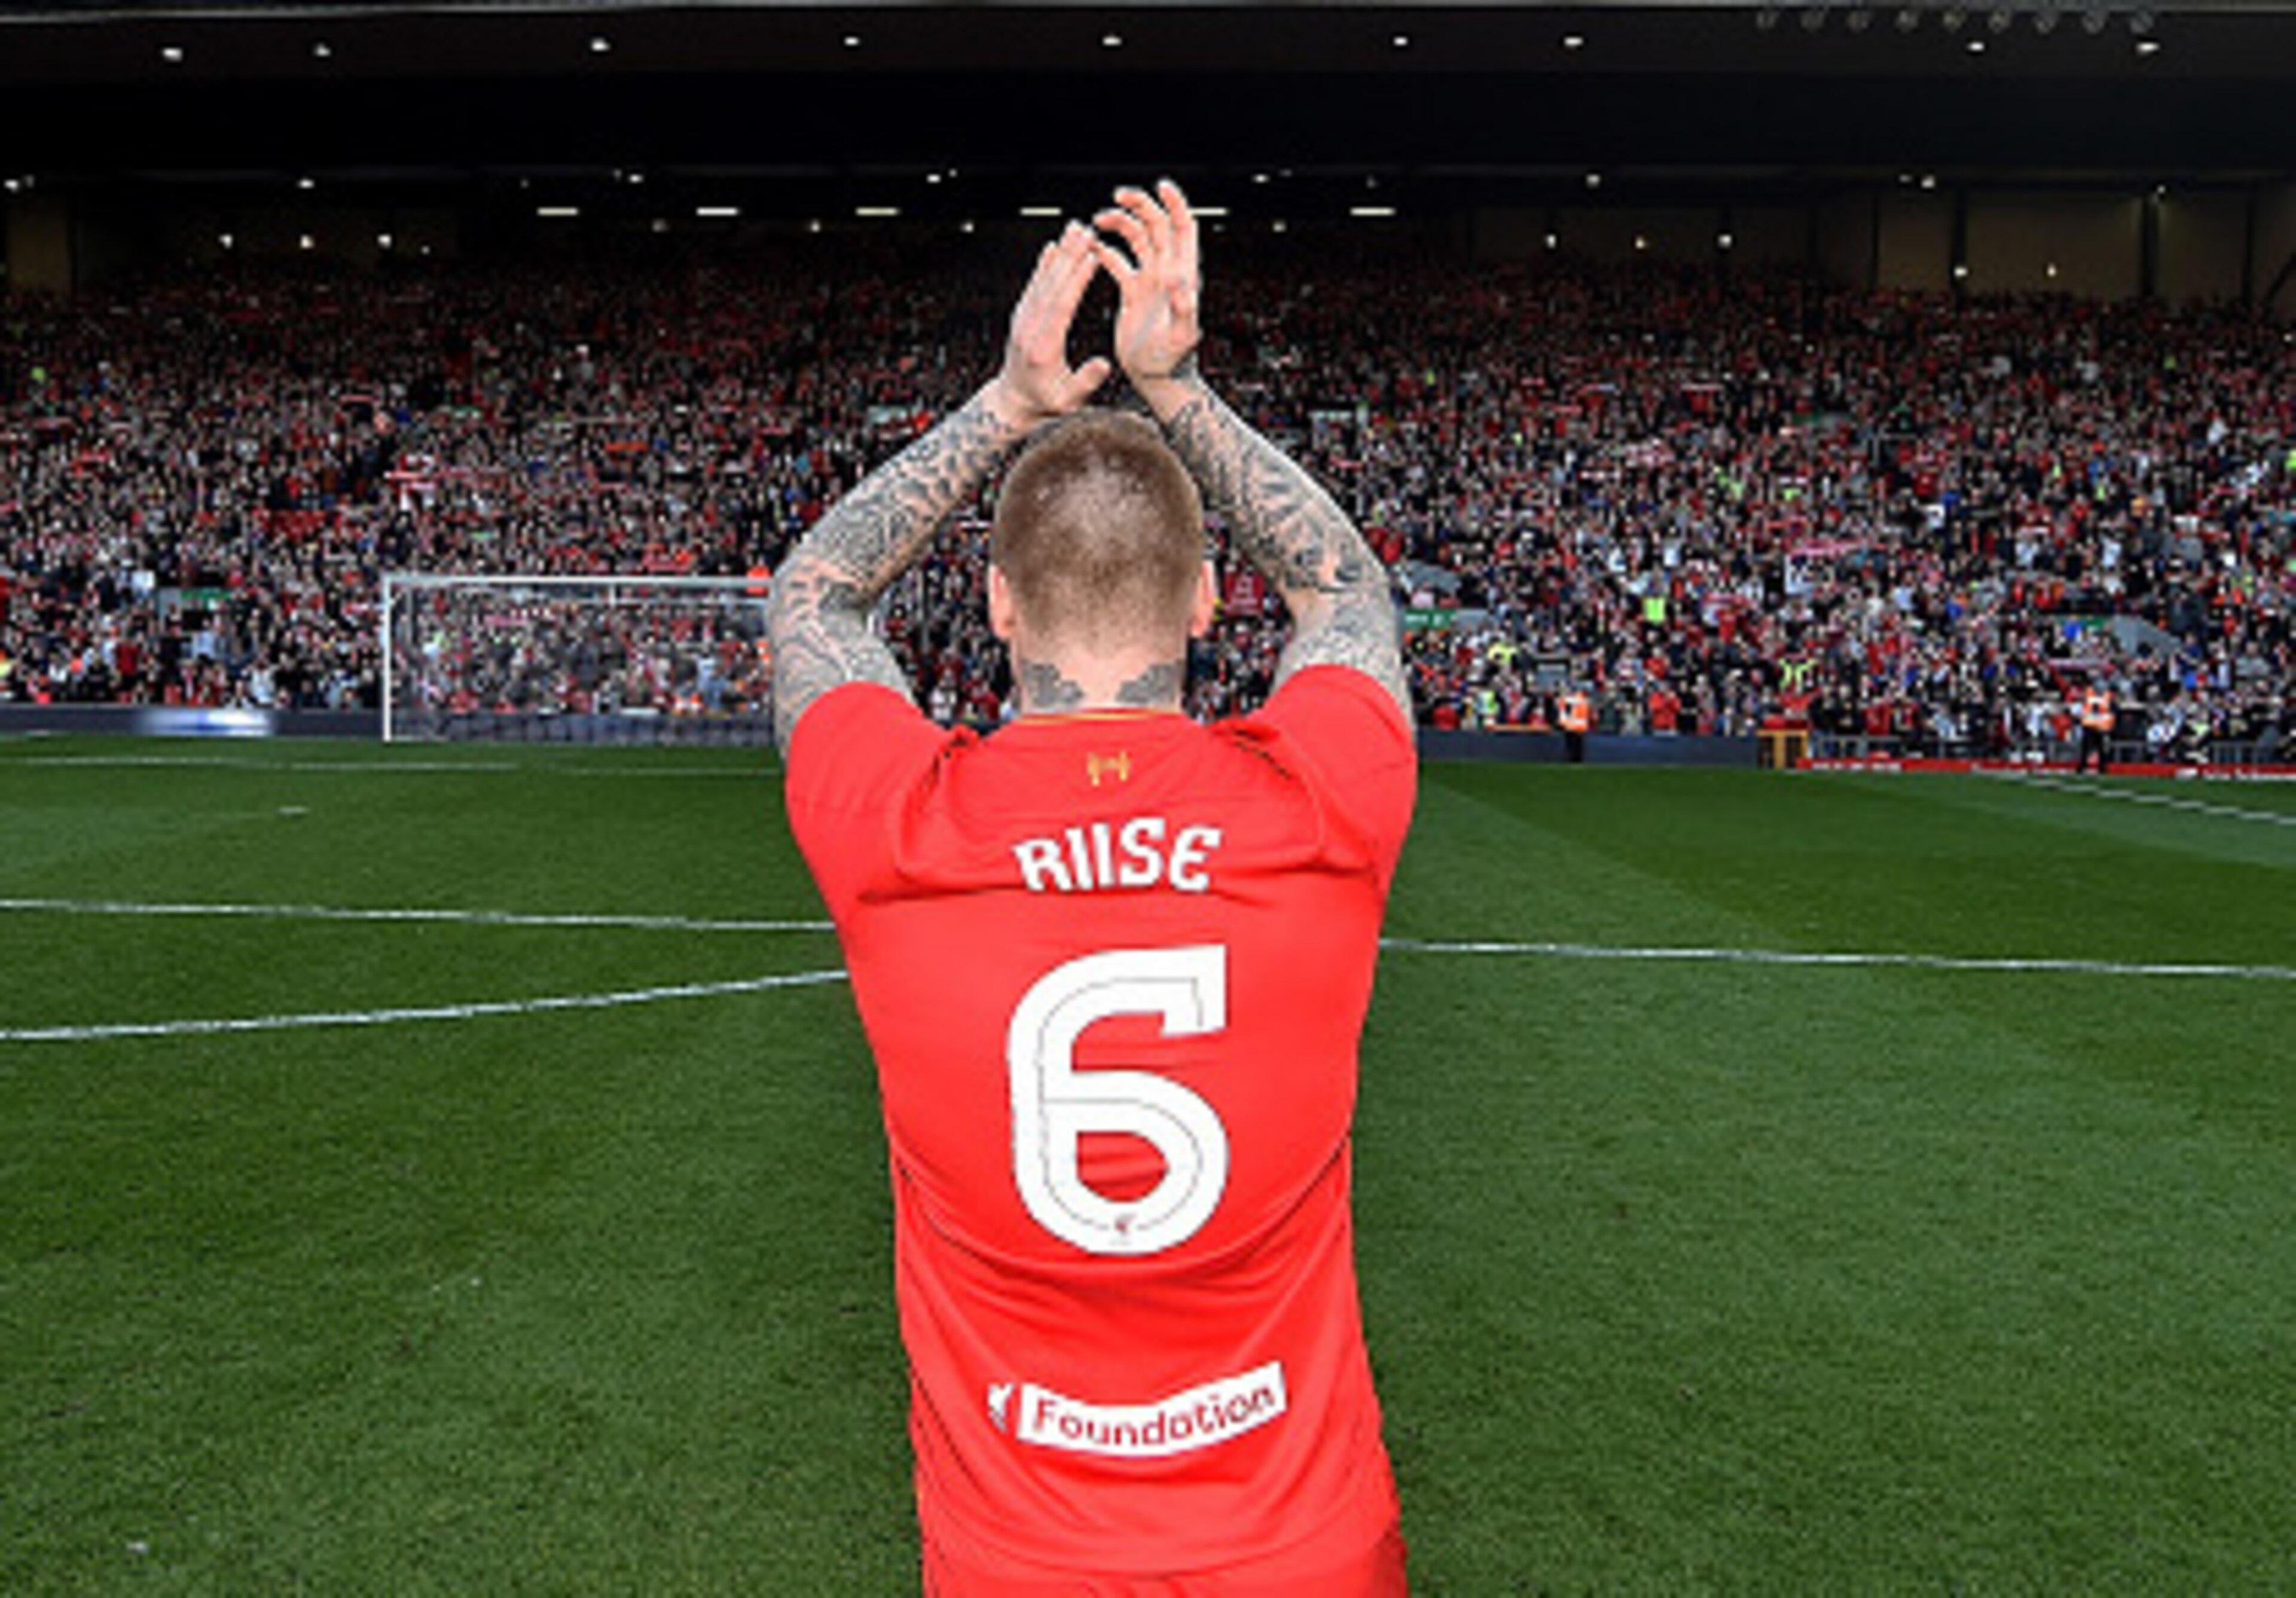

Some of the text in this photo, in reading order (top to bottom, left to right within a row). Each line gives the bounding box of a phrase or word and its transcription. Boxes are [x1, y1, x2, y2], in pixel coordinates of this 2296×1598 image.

[1011, 817, 1224, 892] RIISE
[1007, 945, 1229, 1254] 6
[1032, 1386, 1277, 1446] Foundation
